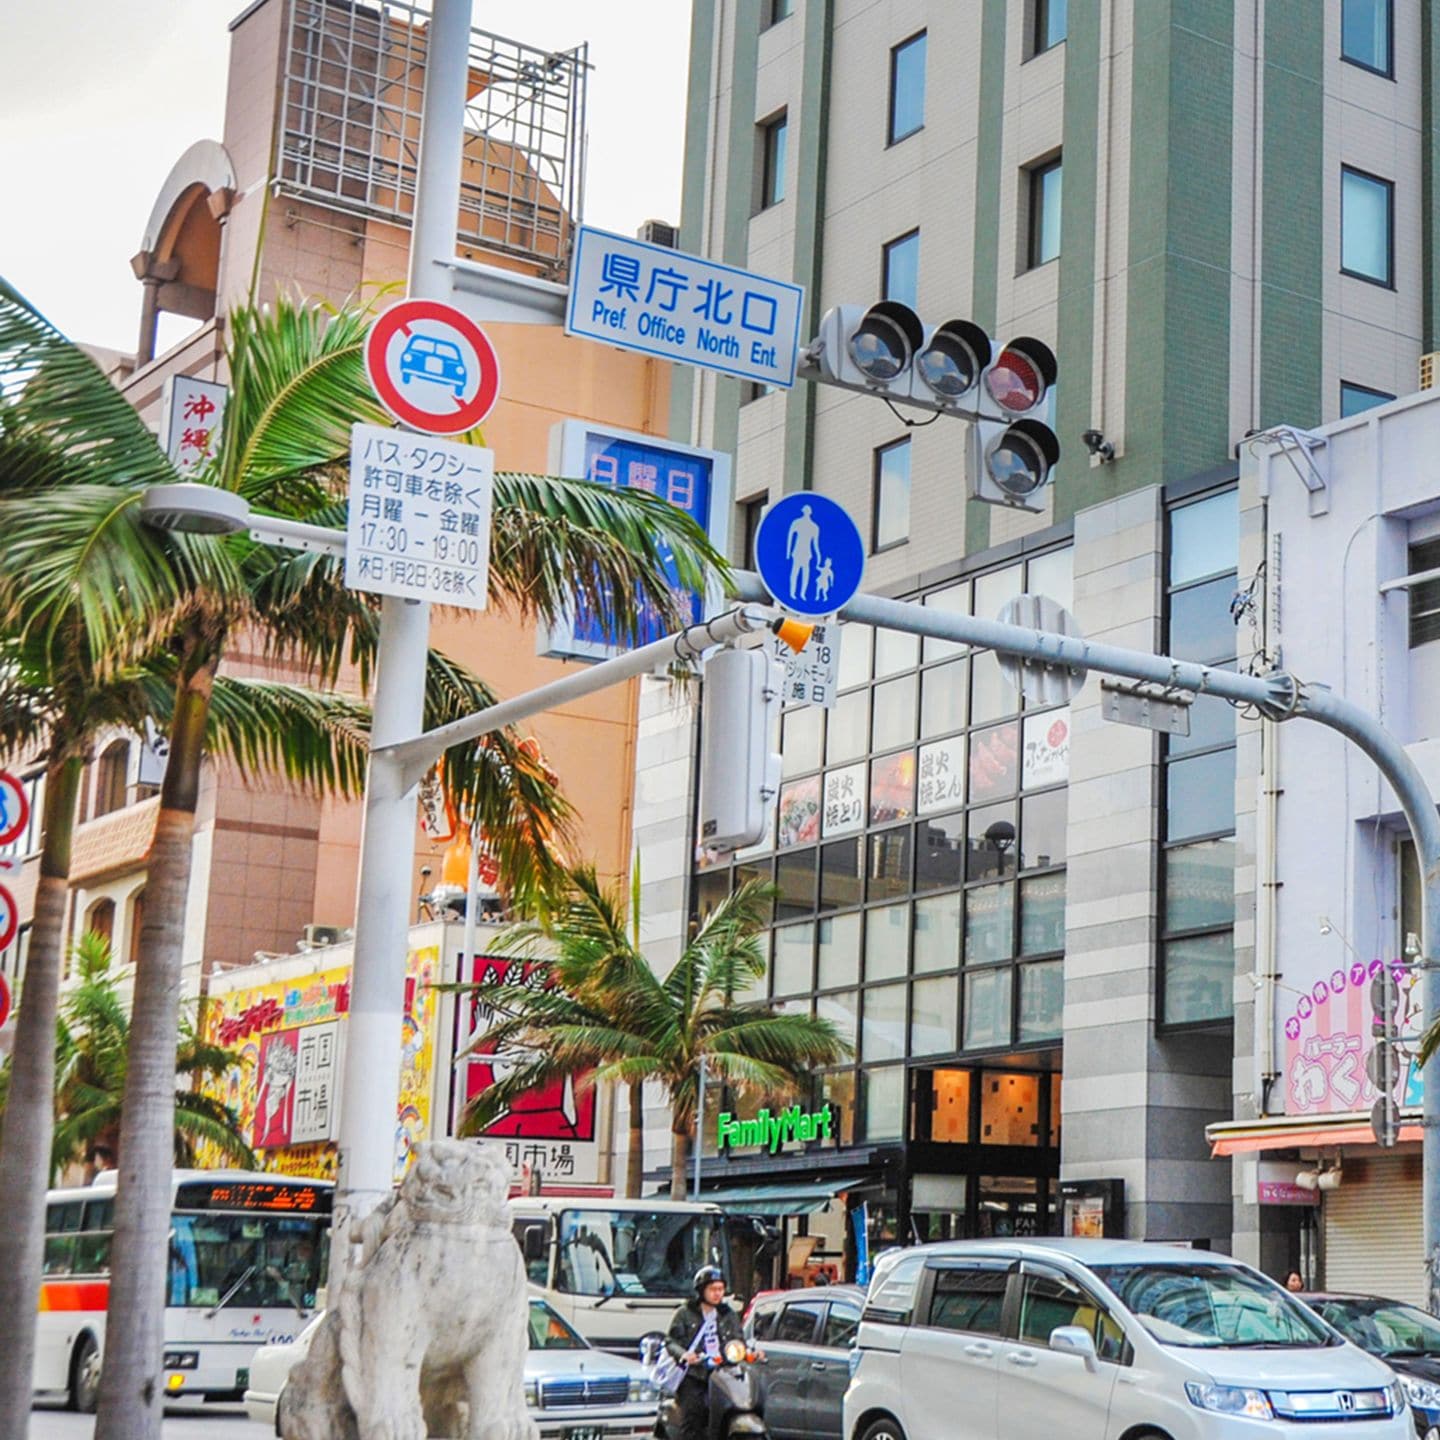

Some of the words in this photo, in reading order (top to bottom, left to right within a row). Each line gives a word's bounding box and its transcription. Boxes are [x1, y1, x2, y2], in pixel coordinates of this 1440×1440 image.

[598, 253, 778, 336] 県庁北口
[592, 300, 627, 331] Pref.
[638, 312, 685, 345] Office
[697, 328, 740, 359] North
[750, 342, 778, 368] Ent.
[182, 393, 216, 464] 沖縄
[363, 465, 481, 509] 許可車を除く
[361, 494, 403, 523] 月曜
[440, 509, 480, 537] 金曜
[360, 523, 408, 553] 17:30
[432, 535, 478, 566] 19:00
[816, 646, 831, 664] 18
[921, 751, 949, 779] 炭火
[828, 774, 854, 801] 炭火
[1289, 1053, 1377, 1110] わく
[717, 1104, 832, 1153] FamilyMart
[505, 1143, 574, 1176] 国市場
